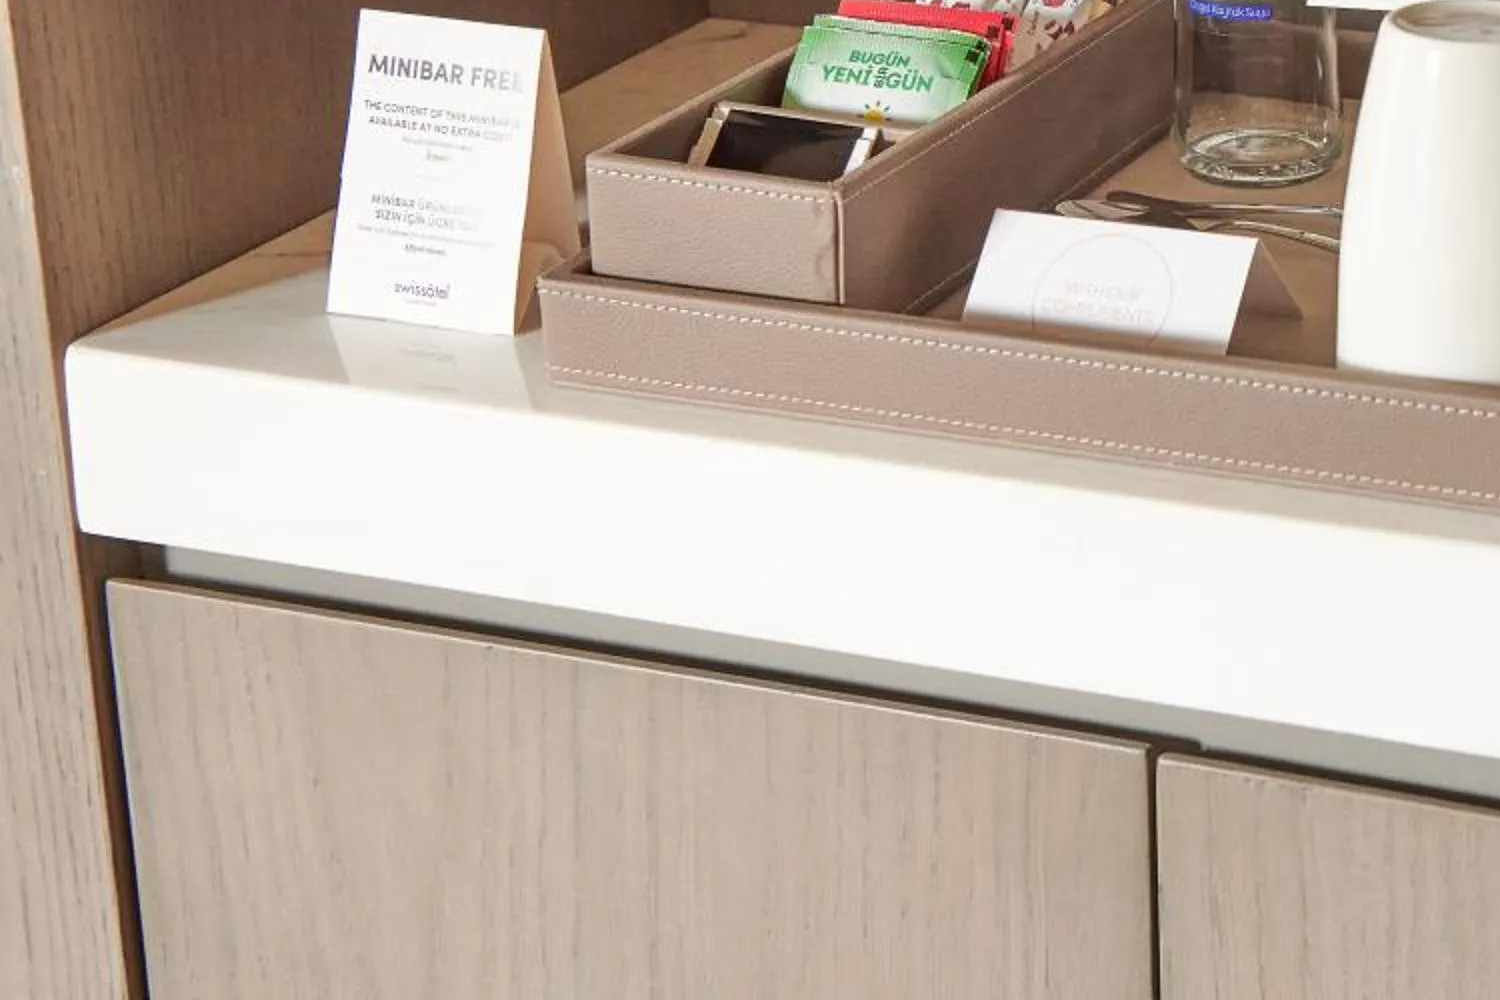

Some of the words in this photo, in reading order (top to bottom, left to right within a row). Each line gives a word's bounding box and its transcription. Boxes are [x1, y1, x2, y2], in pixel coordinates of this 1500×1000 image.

[367, 54, 464, 86] MINIBAR
[848, 49, 911, 68] BUGÜN
[822, 64, 873, 85] YENİ
[886, 69, 935, 93] GÜN
